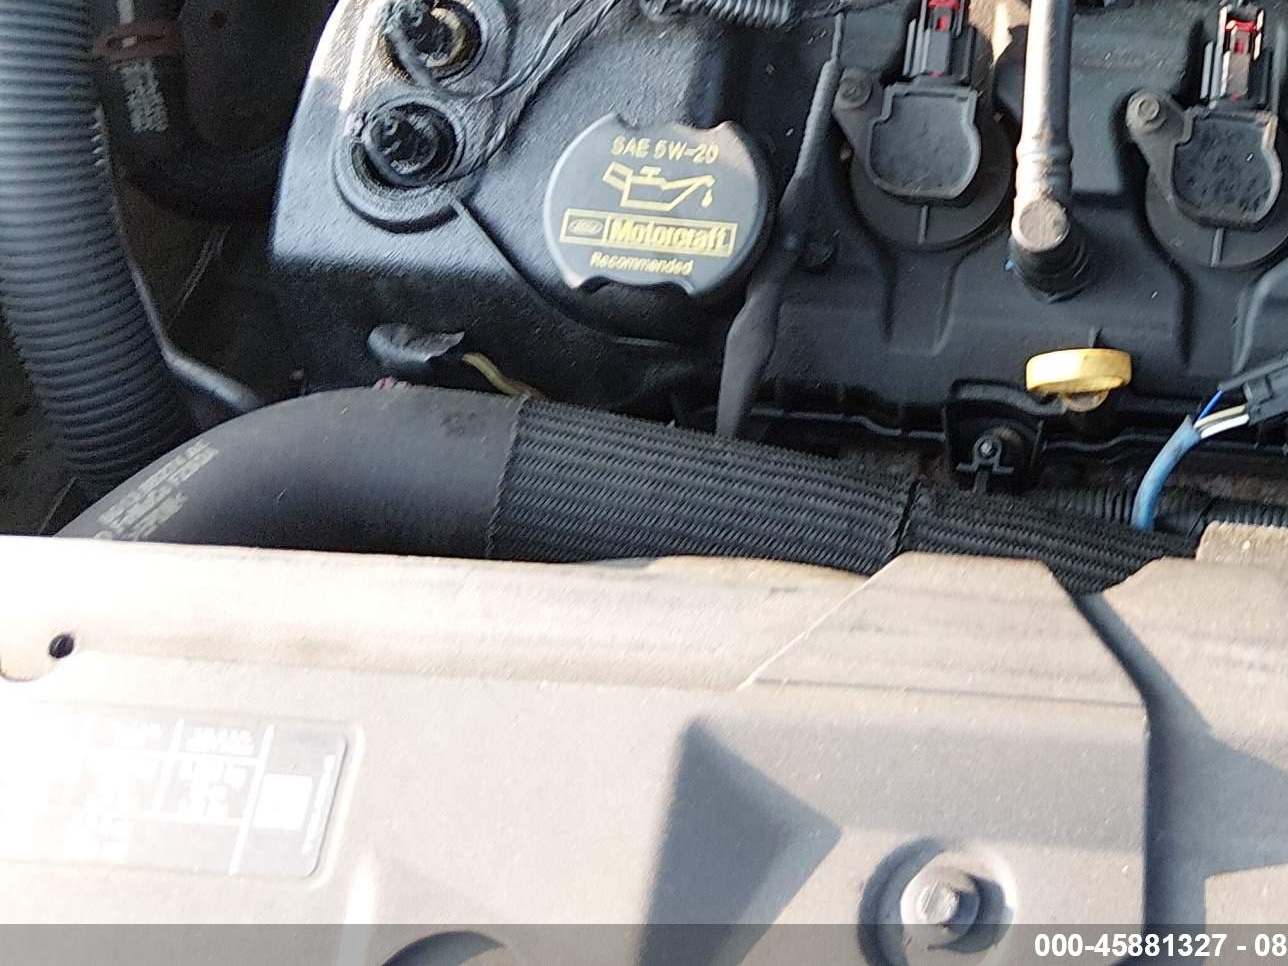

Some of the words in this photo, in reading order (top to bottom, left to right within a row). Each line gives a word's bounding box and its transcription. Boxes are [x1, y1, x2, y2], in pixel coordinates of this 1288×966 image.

[611, 135, 651, 158] SAE
[654, 139, 719, 164] 5W-20
[608, 218, 730, 251] Motorcraft
[590, 251, 694, 275] Recommended
